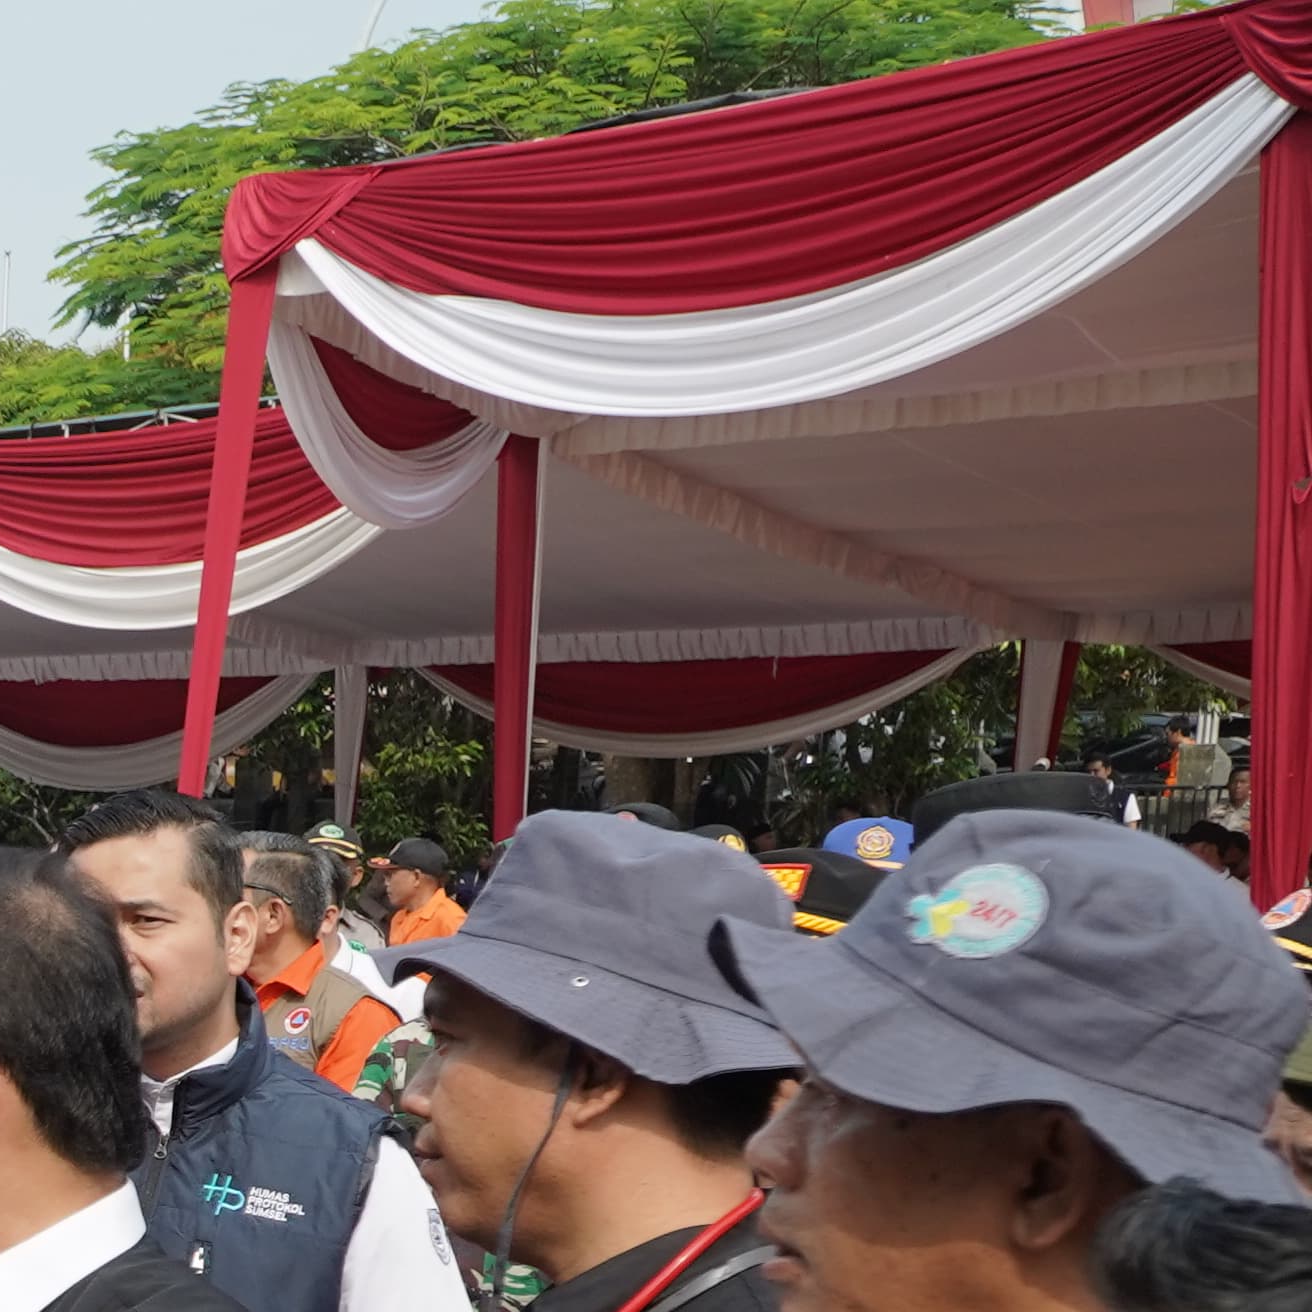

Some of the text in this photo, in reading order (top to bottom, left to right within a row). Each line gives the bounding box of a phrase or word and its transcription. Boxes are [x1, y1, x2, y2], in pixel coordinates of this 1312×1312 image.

[249, 1186, 290, 1203] HUMAS
[244, 1205, 288, 1222] SUMSEL
[246, 1195, 306, 1216] PROTOKOL
